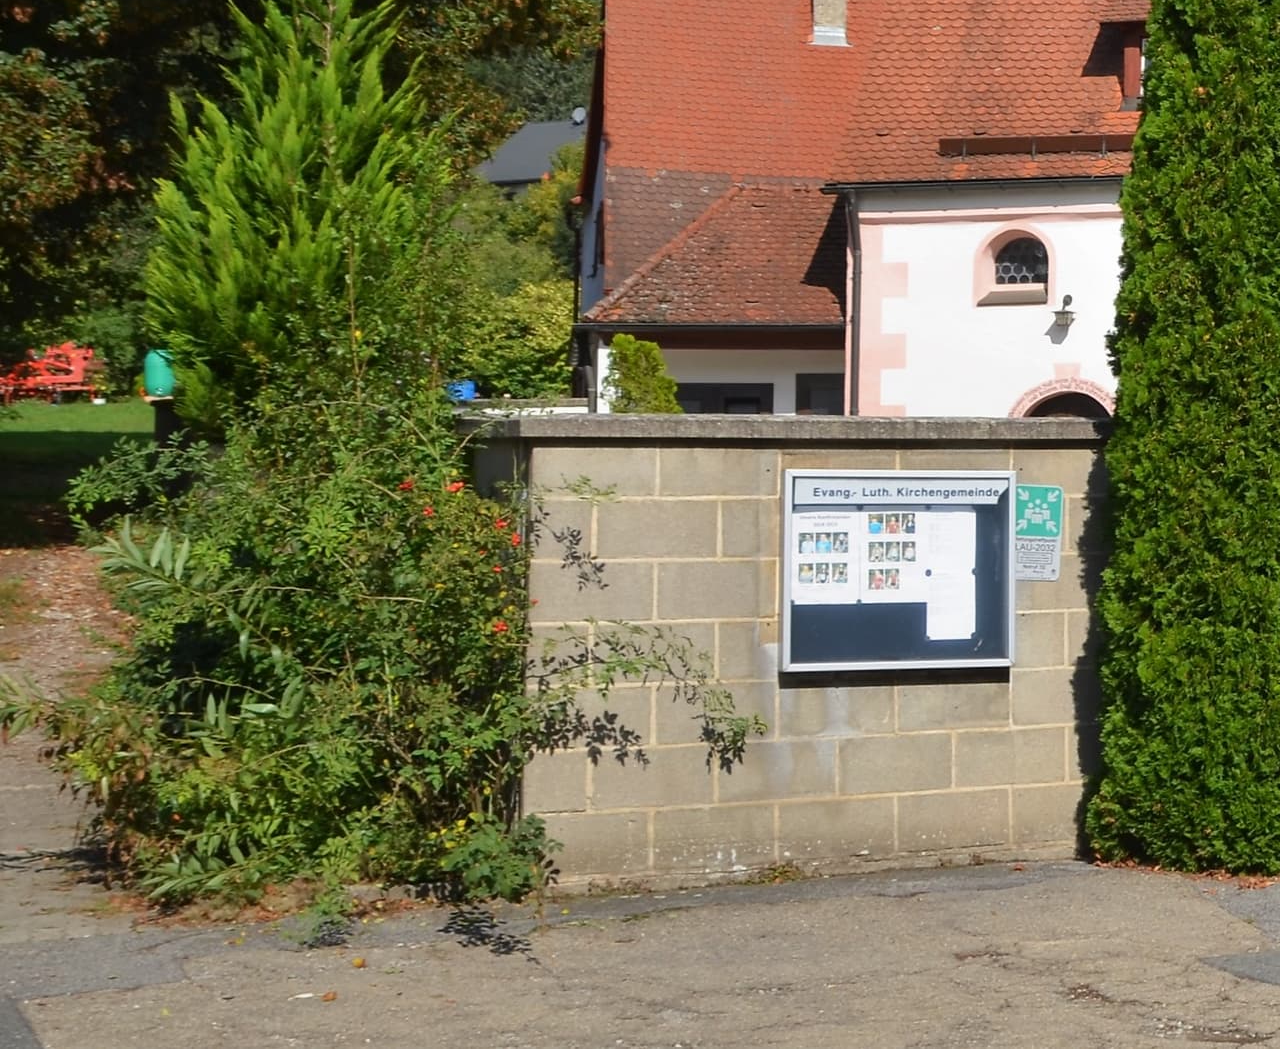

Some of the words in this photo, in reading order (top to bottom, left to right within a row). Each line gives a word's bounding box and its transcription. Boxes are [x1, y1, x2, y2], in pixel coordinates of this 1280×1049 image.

[813, 487, 857, 499] Evang.-
[862, 487, 893, 497] Luth.
[897, 487, 1000, 499] Kirchengemeinde
[1015, 542, 1057, 552] LAU-2032
